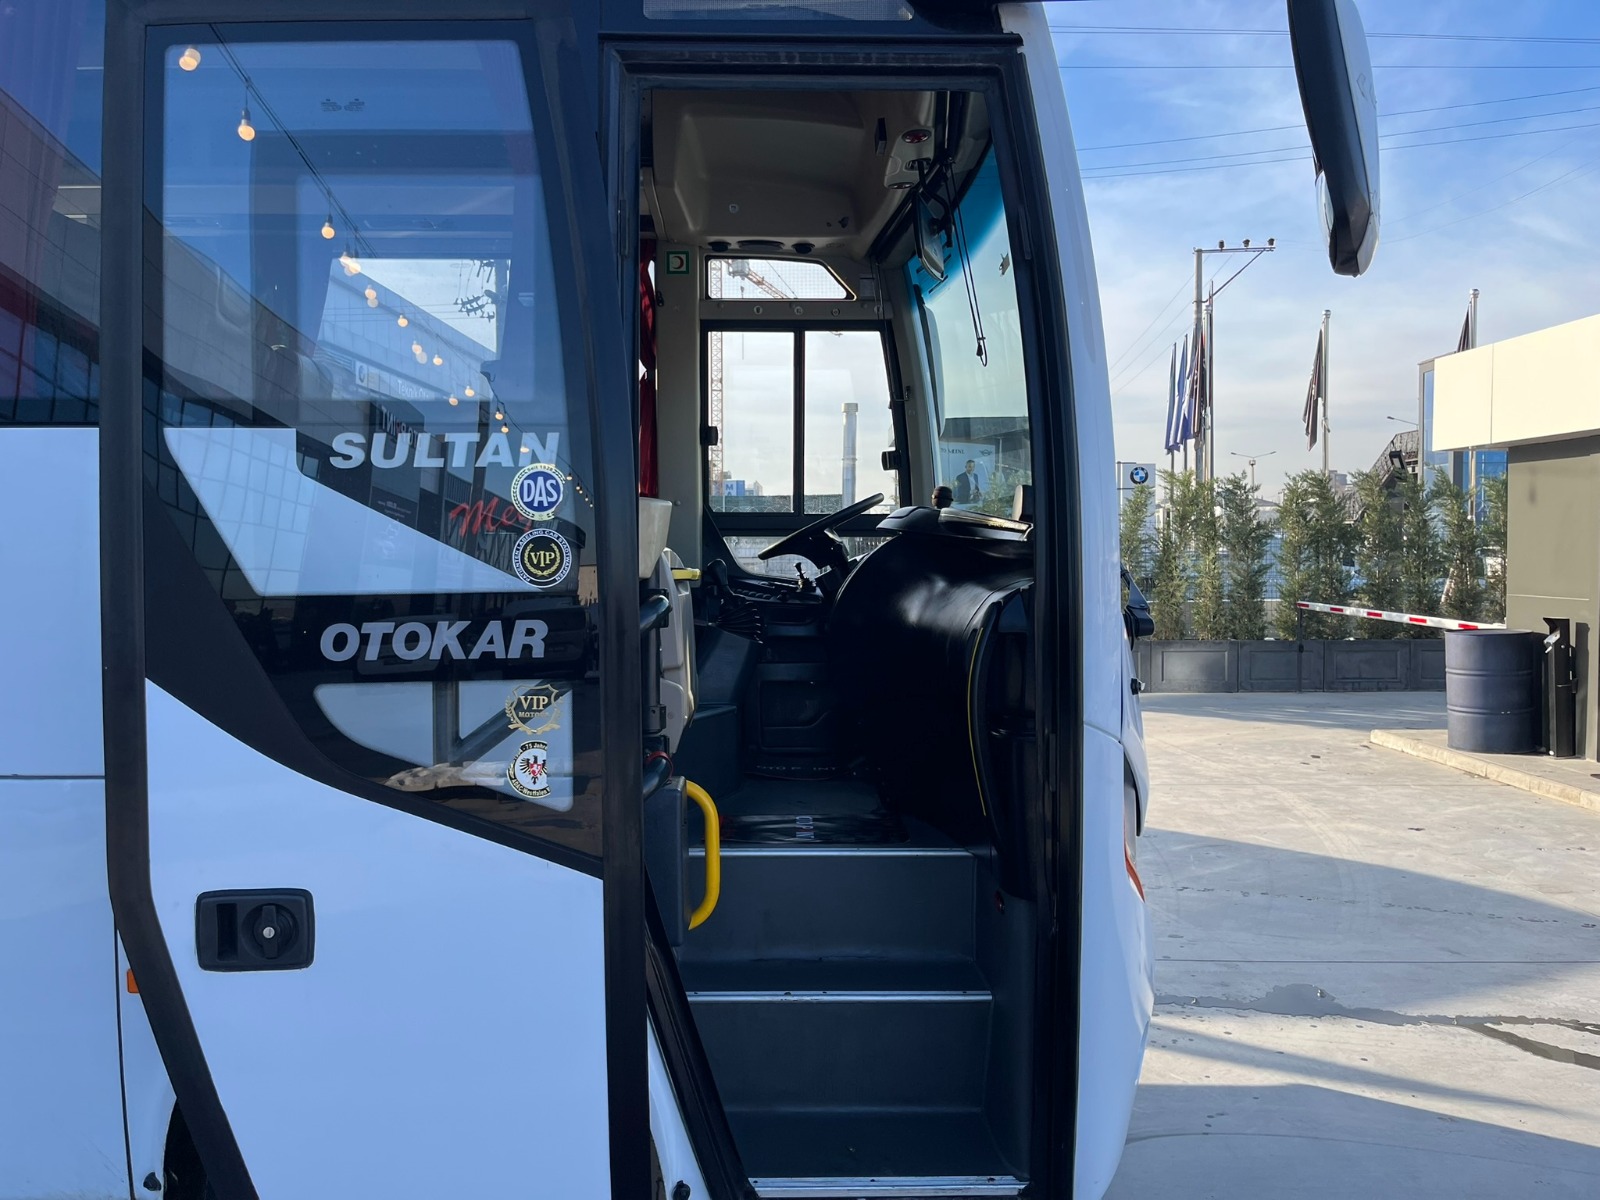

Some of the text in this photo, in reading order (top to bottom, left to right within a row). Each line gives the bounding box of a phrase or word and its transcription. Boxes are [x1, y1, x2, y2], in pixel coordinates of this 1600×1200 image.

[329, 432, 560, 469] SULTAN
[523, 476, 557, 507] DAS
[529, 551, 555, 567] VIP
[319, 619, 549, 662] OTOKAR
[519, 695, 549, 710] VIP
